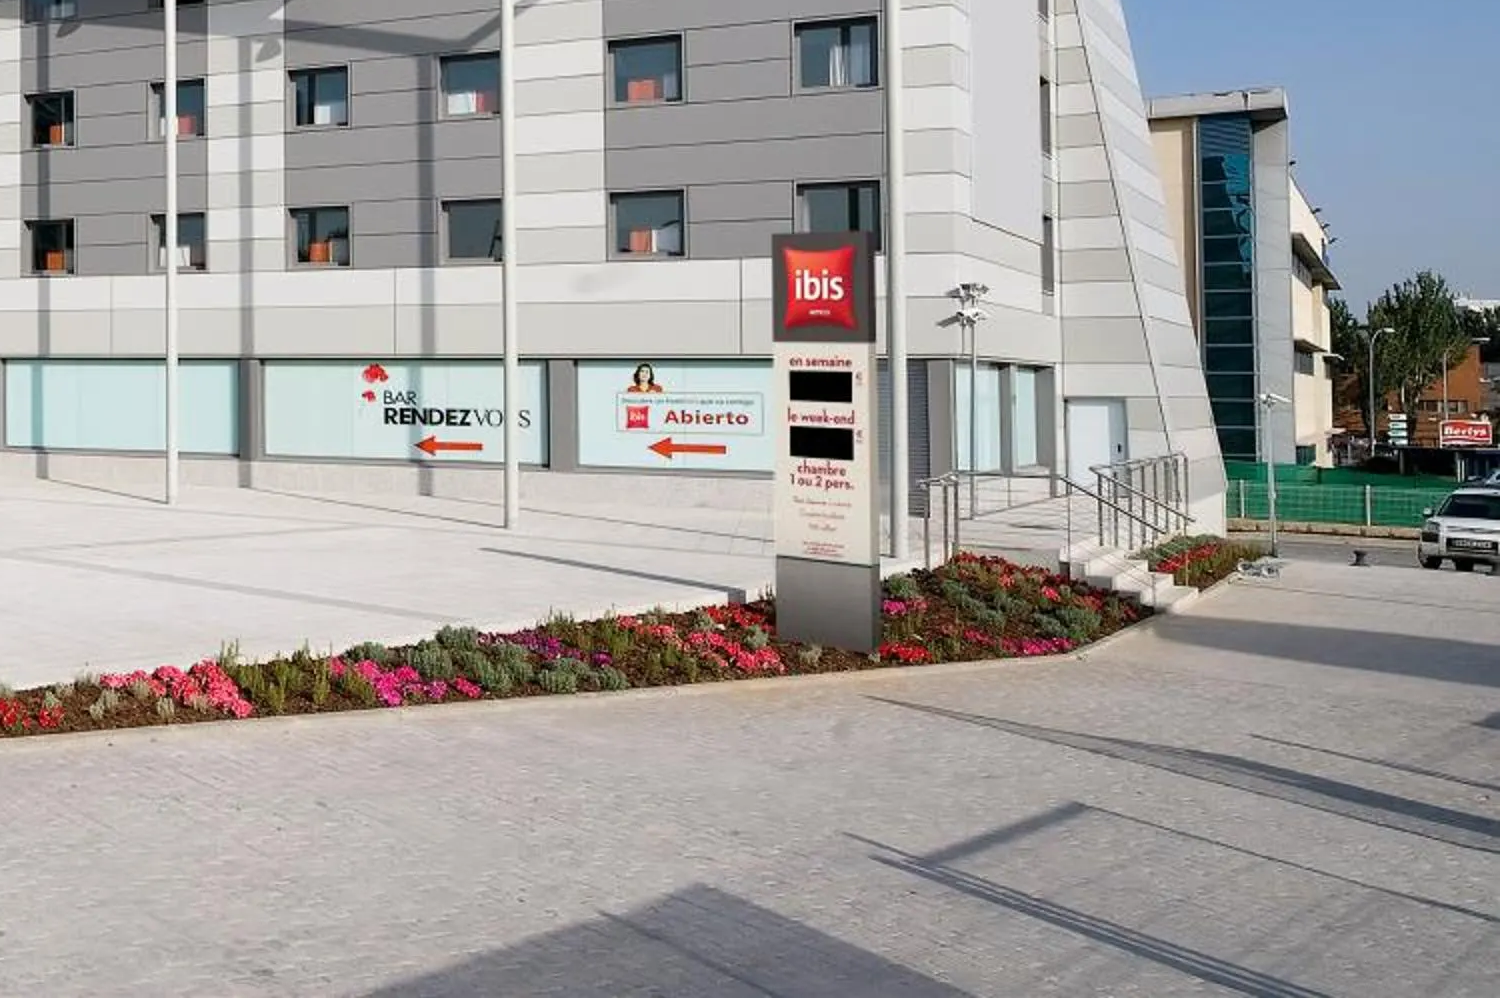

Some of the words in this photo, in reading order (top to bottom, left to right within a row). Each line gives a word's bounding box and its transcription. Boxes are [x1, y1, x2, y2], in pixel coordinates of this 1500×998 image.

[795, 269, 844, 300] ibis
[789, 357, 803, 367] en
[805, 355, 853, 368] semaine
[384, 390, 417, 405] BAR
[665, 409, 749, 425] Abierto
[787, 406, 798, 422] le
[797, 459, 846, 477] chambre
[797, 477, 813, 487] ou
[815, 475, 823, 488] 2
